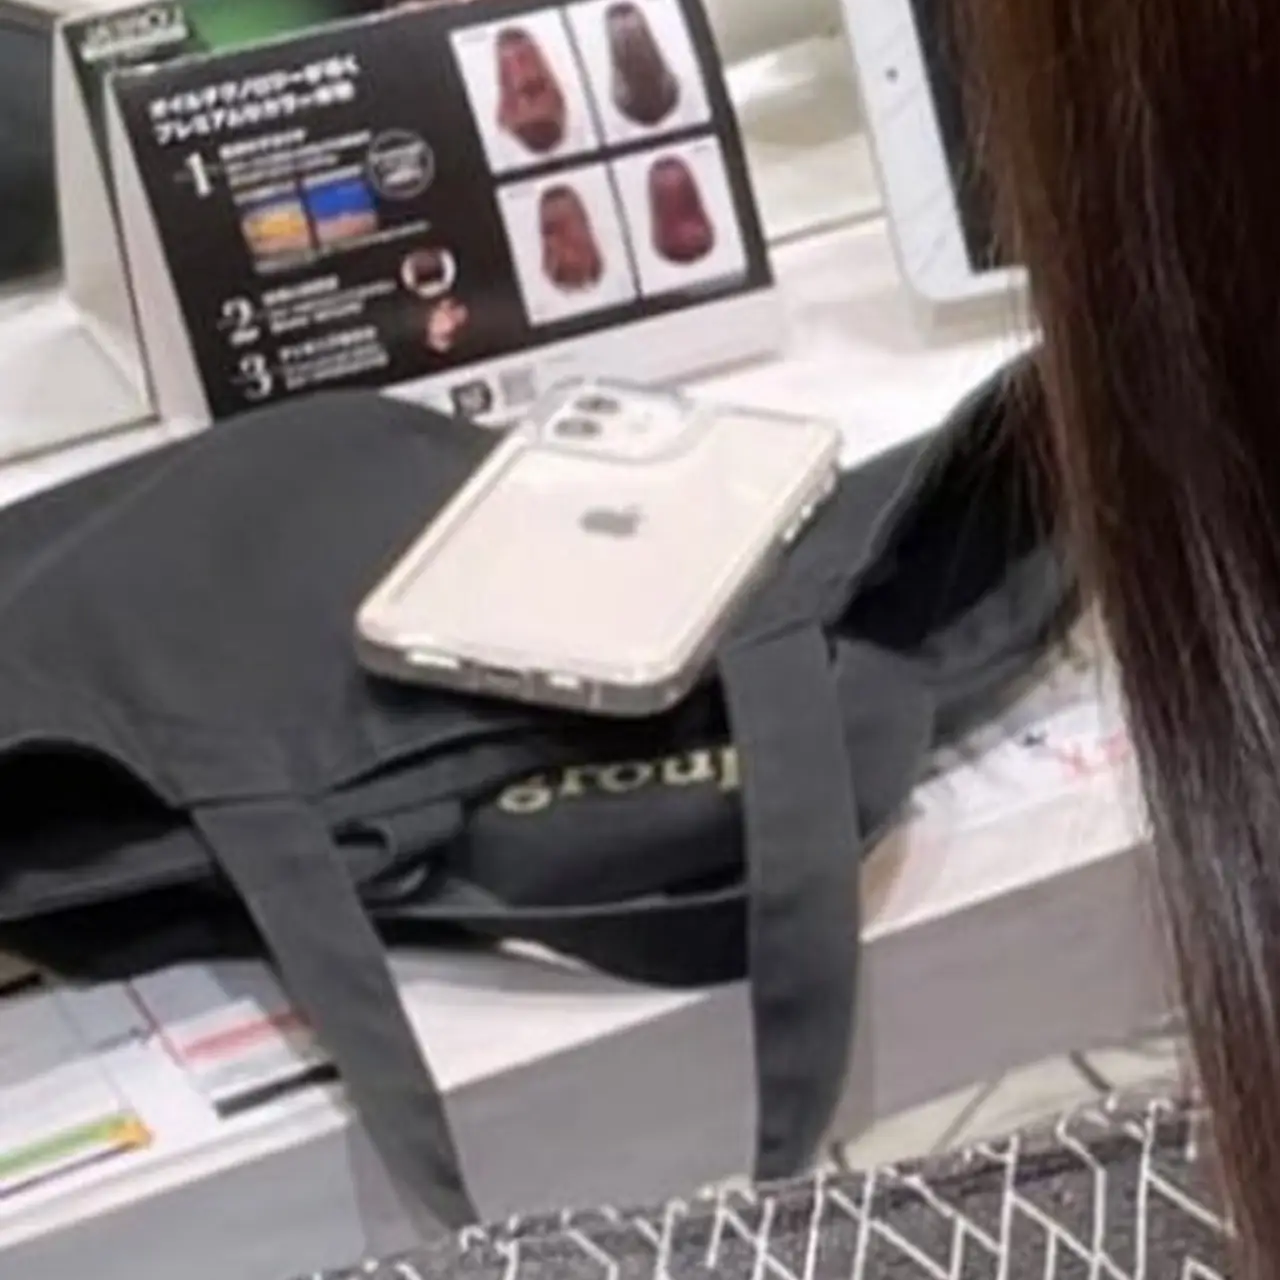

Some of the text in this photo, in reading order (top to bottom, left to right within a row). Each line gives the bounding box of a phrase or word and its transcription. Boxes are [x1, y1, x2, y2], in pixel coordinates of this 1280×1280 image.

[186, 152, 212, 197] 1
[220, 297, 260, 346] 2
[238, 354, 273, 401] 3
